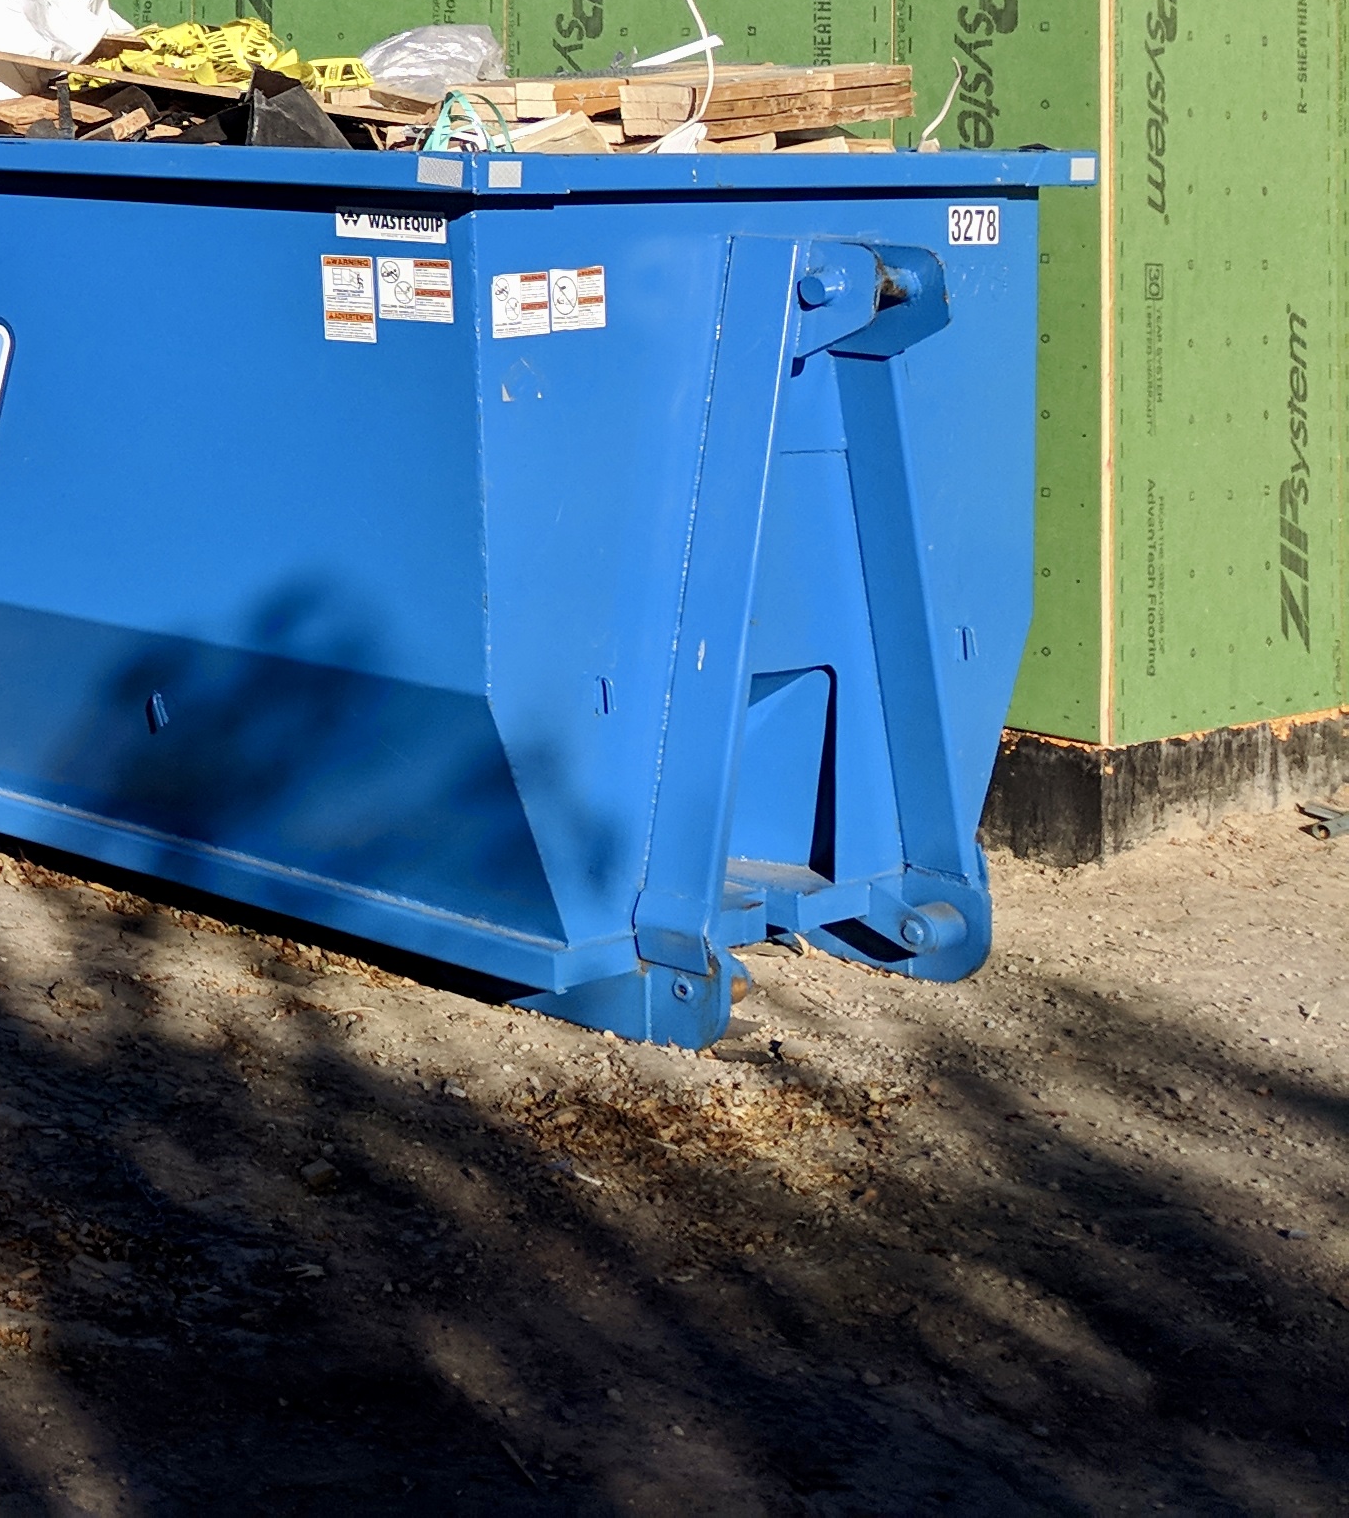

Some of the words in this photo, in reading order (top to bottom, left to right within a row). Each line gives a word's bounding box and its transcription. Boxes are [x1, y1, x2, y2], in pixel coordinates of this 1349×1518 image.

[367, 214, 444, 233] WASTEQUIP
[951, 209, 996, 242] 3278
[1149, 268, 1161, 297] 30
[1147, 479, 1157, 589] AdvanTech
[1147, 593, 1157, 677] Flooring
